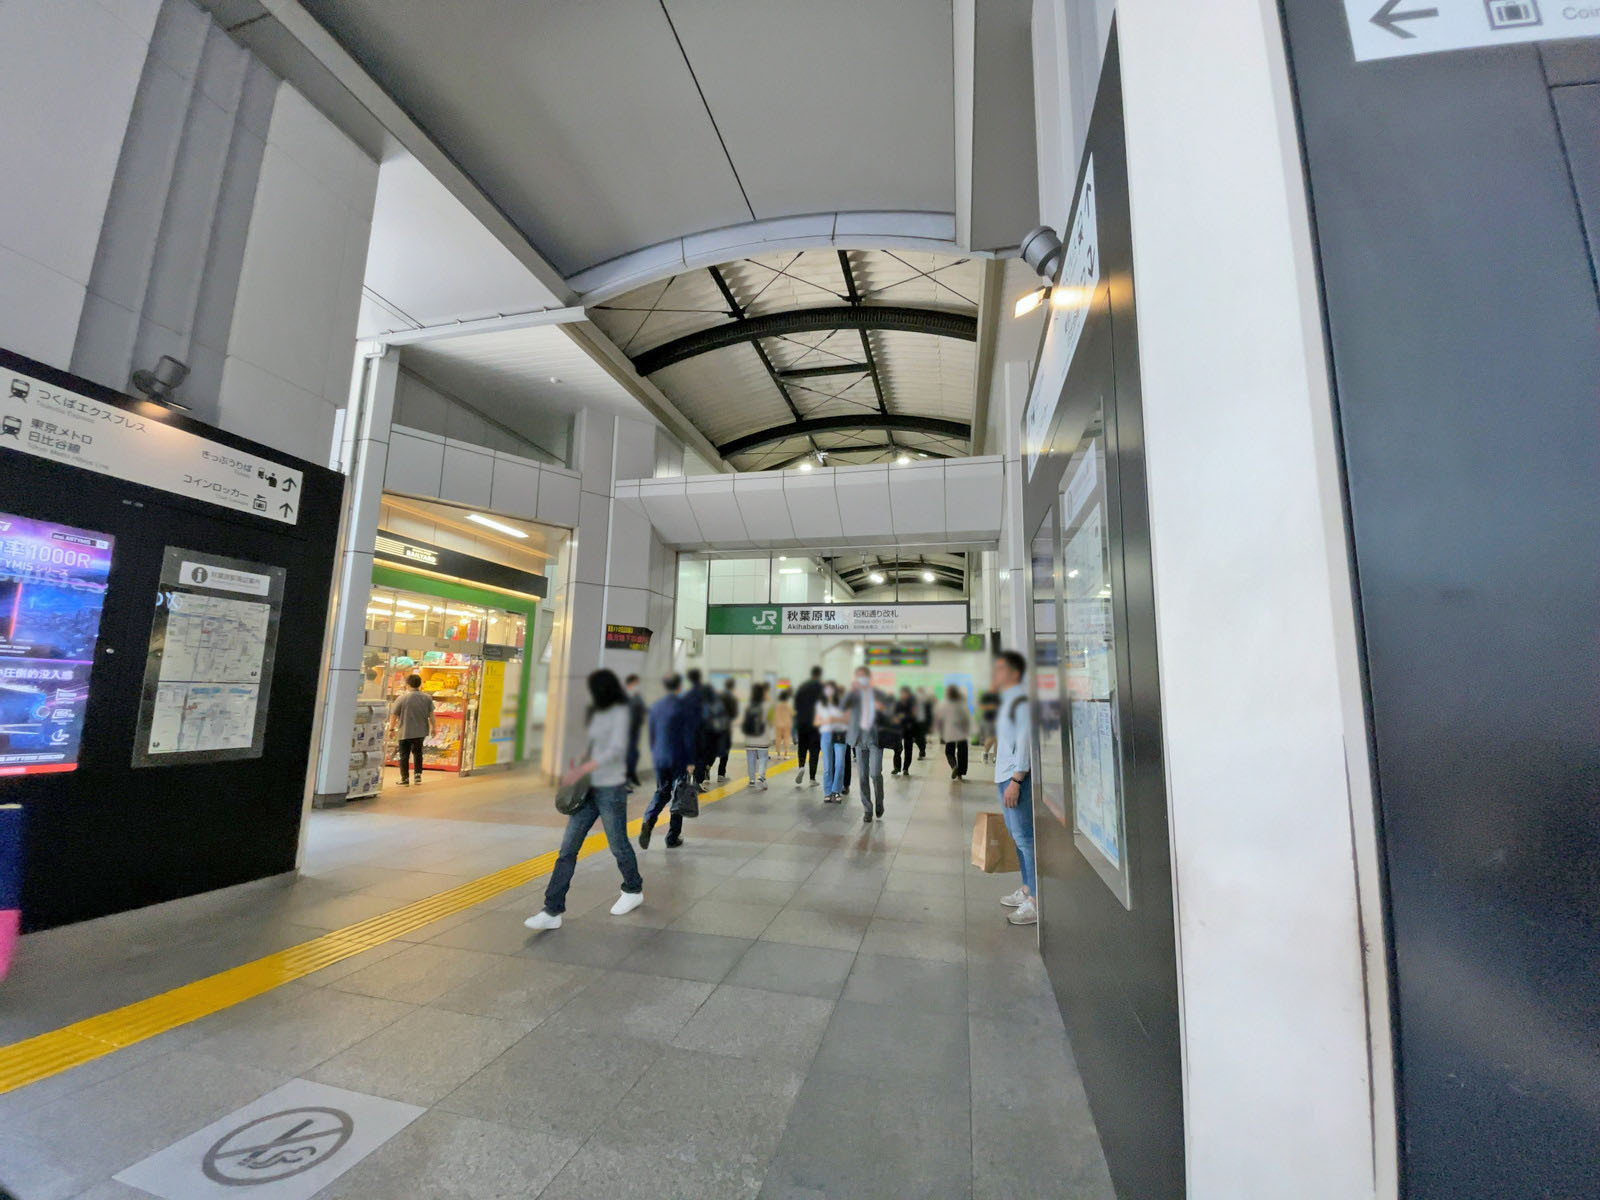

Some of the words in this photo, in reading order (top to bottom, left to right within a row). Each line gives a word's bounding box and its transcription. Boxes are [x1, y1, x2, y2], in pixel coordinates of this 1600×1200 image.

[39, 389, 146, 433] つくばエクスプレス
[31, 418, 93, 440] 東京メトロ
[28, 430, 81, 453] 日比谷線
[202, 450, 252, 472] きっぷうりば
[183, 474, 249, 497] コインロッカー
[0, 538, 91, 568] 率1000R
[752, 610, 777, 625] JR
[787, 610, 836, 621] 秋葉原駅
